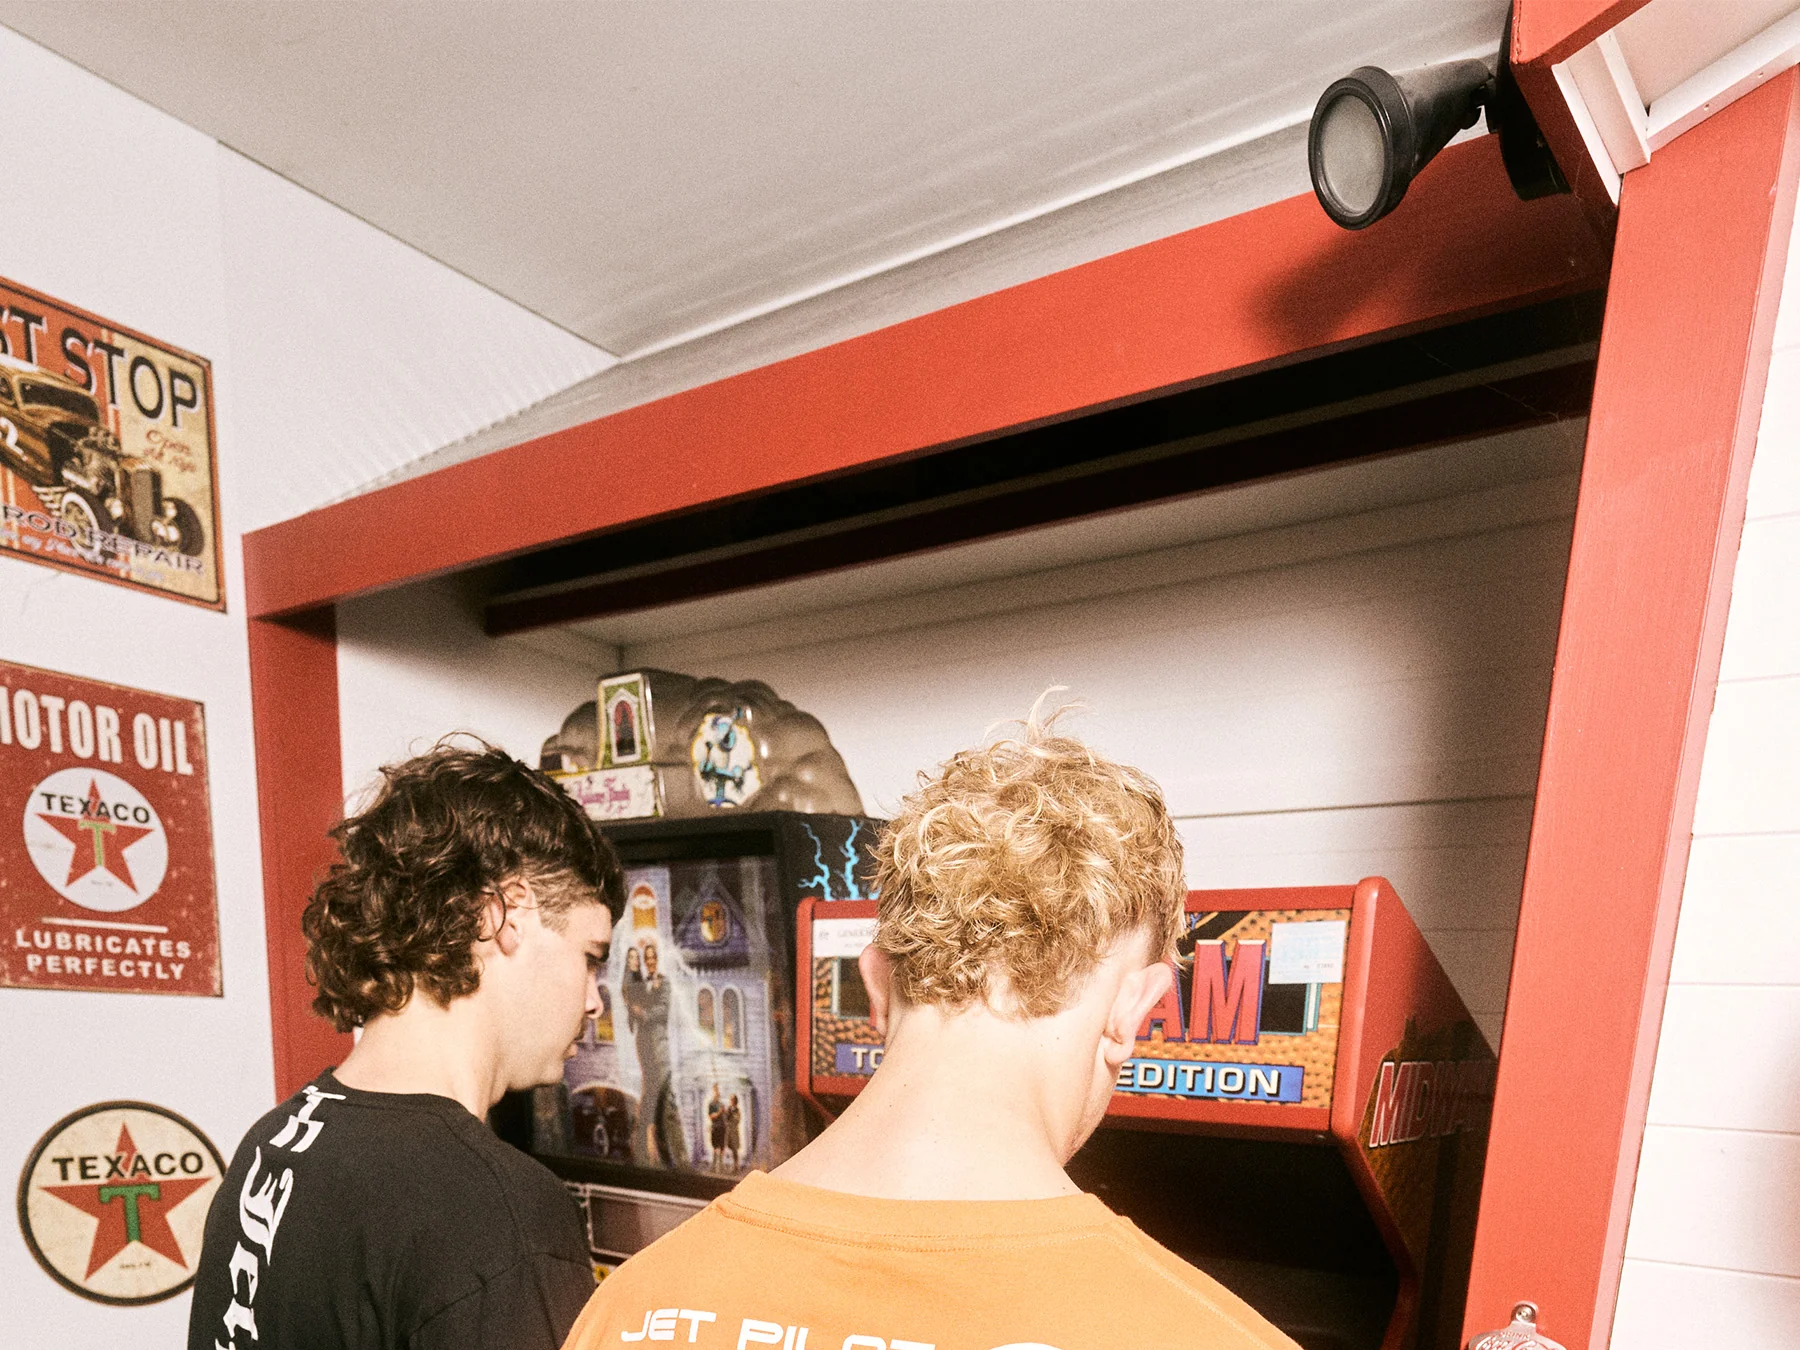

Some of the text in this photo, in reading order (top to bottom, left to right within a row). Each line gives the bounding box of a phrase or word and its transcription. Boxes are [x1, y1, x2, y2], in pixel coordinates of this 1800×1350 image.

[60, 327, 201, 430] STOP
[2, 505, 77, 540] ROD
[87, 529, 205, 573] REPAIR
[132, 712, 194, 776] OIL
[40, 792, 150, 824] TEXACO
[15, 928, 191, 958] LUBRICATES
[26, 954, 185, 980] PERFECTLY
[1116, 1062, 1281, 1097] EDITION
[52, 1152, 204, 1181] TEXACO
[621, 1308, 717, 1342] JET
